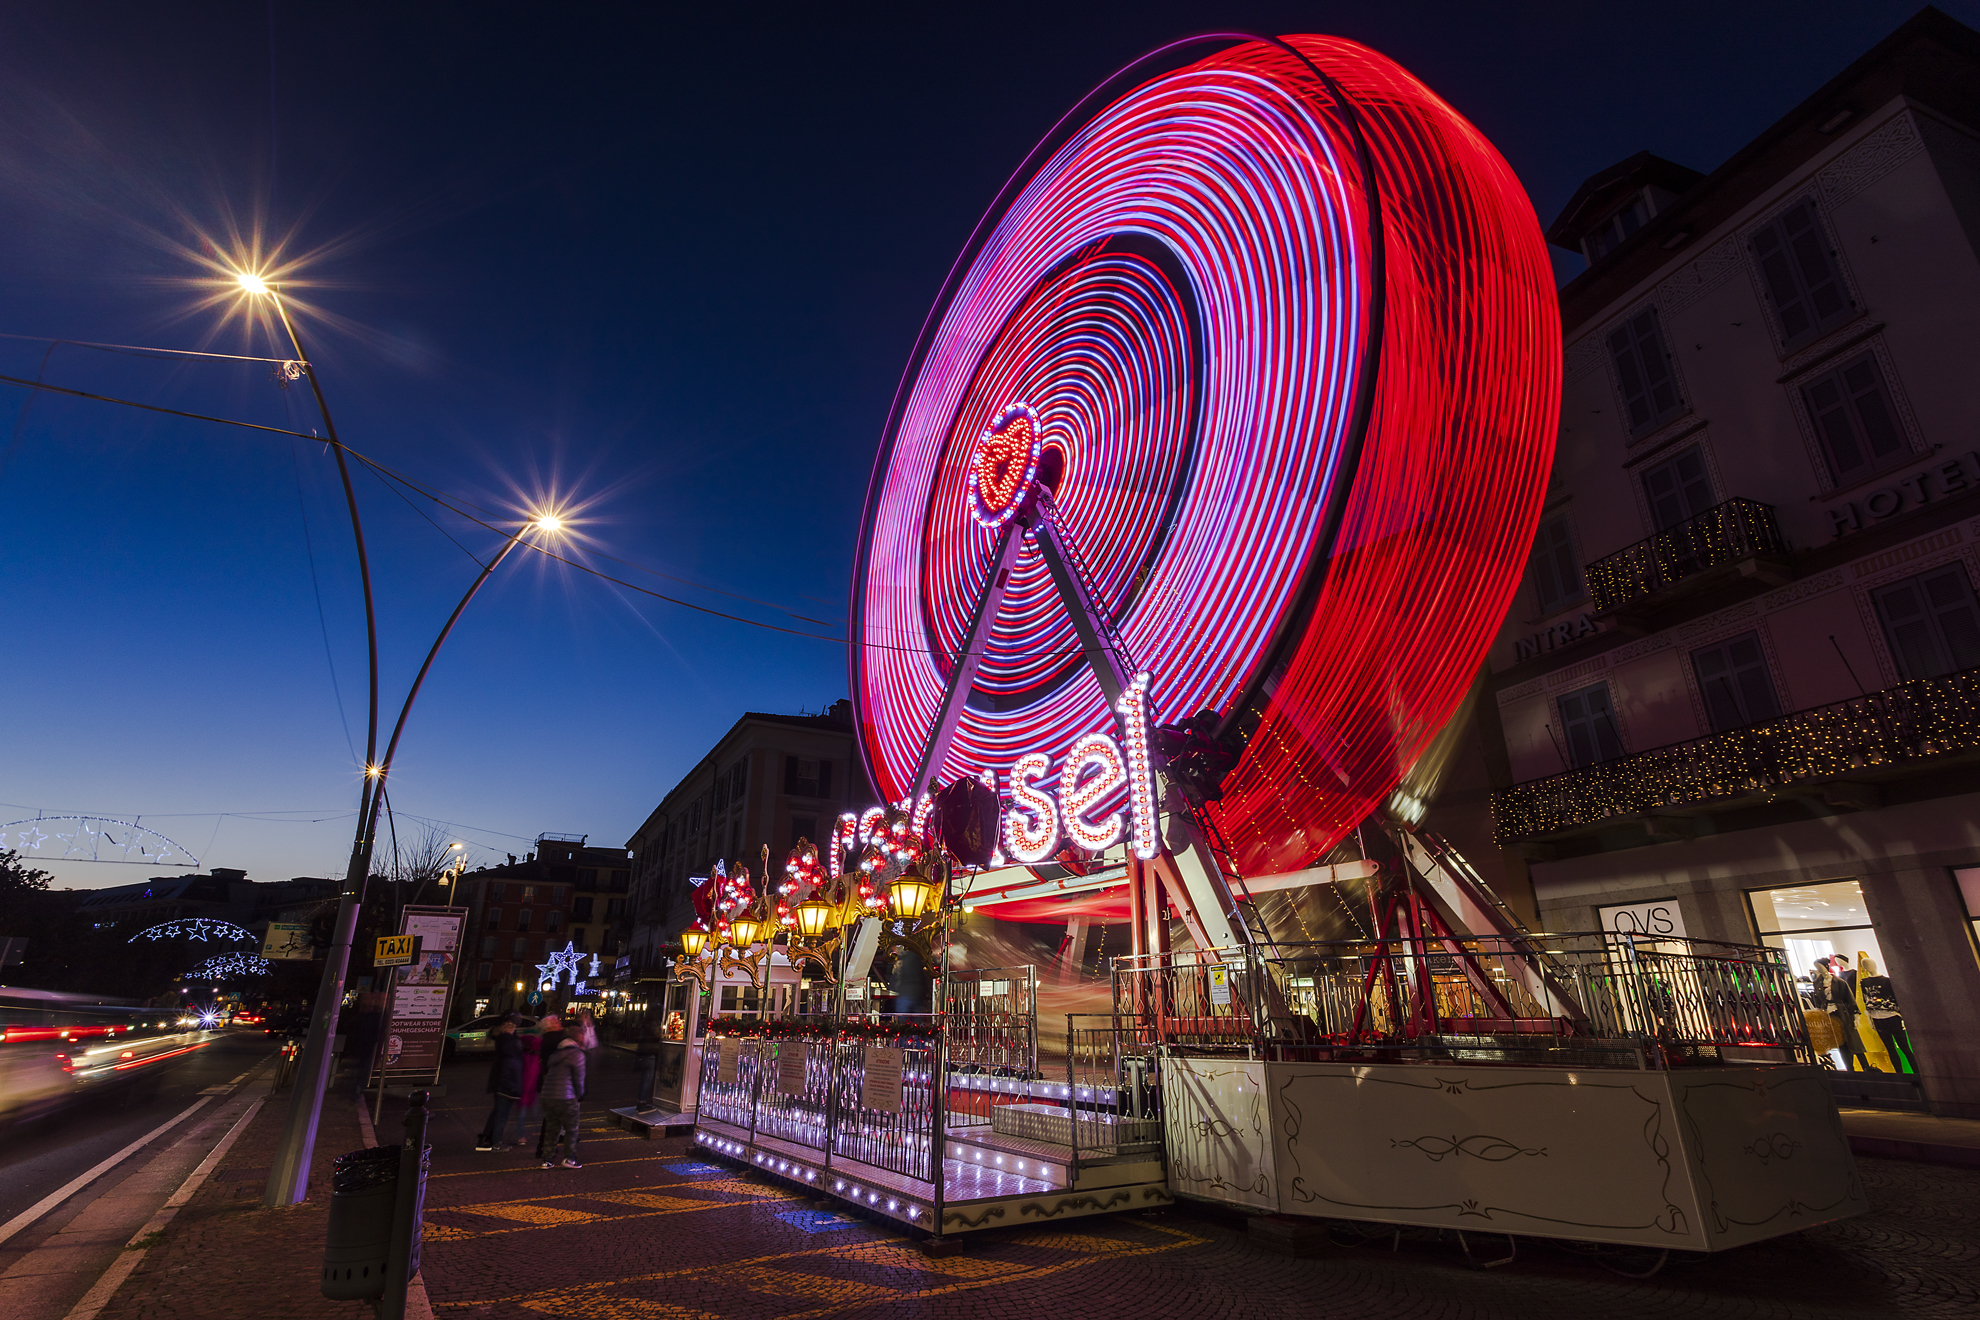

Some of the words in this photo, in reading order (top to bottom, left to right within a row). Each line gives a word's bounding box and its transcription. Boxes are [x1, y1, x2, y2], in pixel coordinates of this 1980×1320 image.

[1511, 613, 1598, 662] INTRA
[1614, 907, 1674, 936] OVS
[379, 938, 411, 955] TAXI
